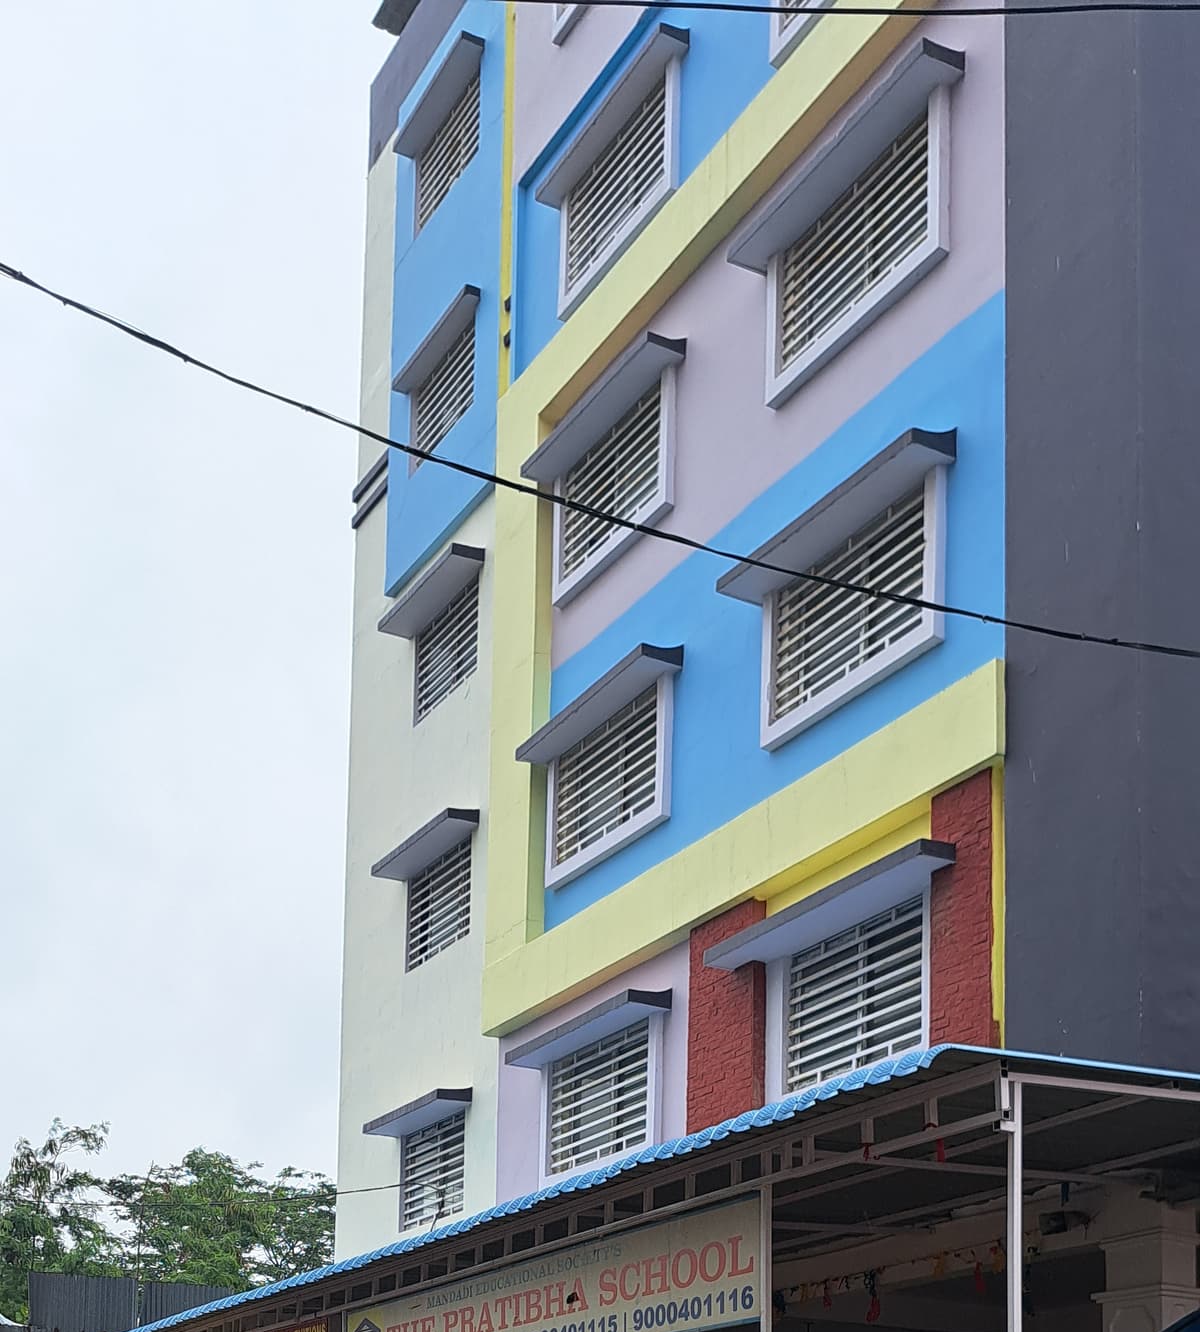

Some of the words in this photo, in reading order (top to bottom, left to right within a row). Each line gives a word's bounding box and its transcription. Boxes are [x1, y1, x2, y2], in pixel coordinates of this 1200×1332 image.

[475, 1261, 554, 1296] EDUCATIONAL
[598, 1235, 754, 1306] SCHOOL
[632, 1285, 754, 1331] 9000401116
